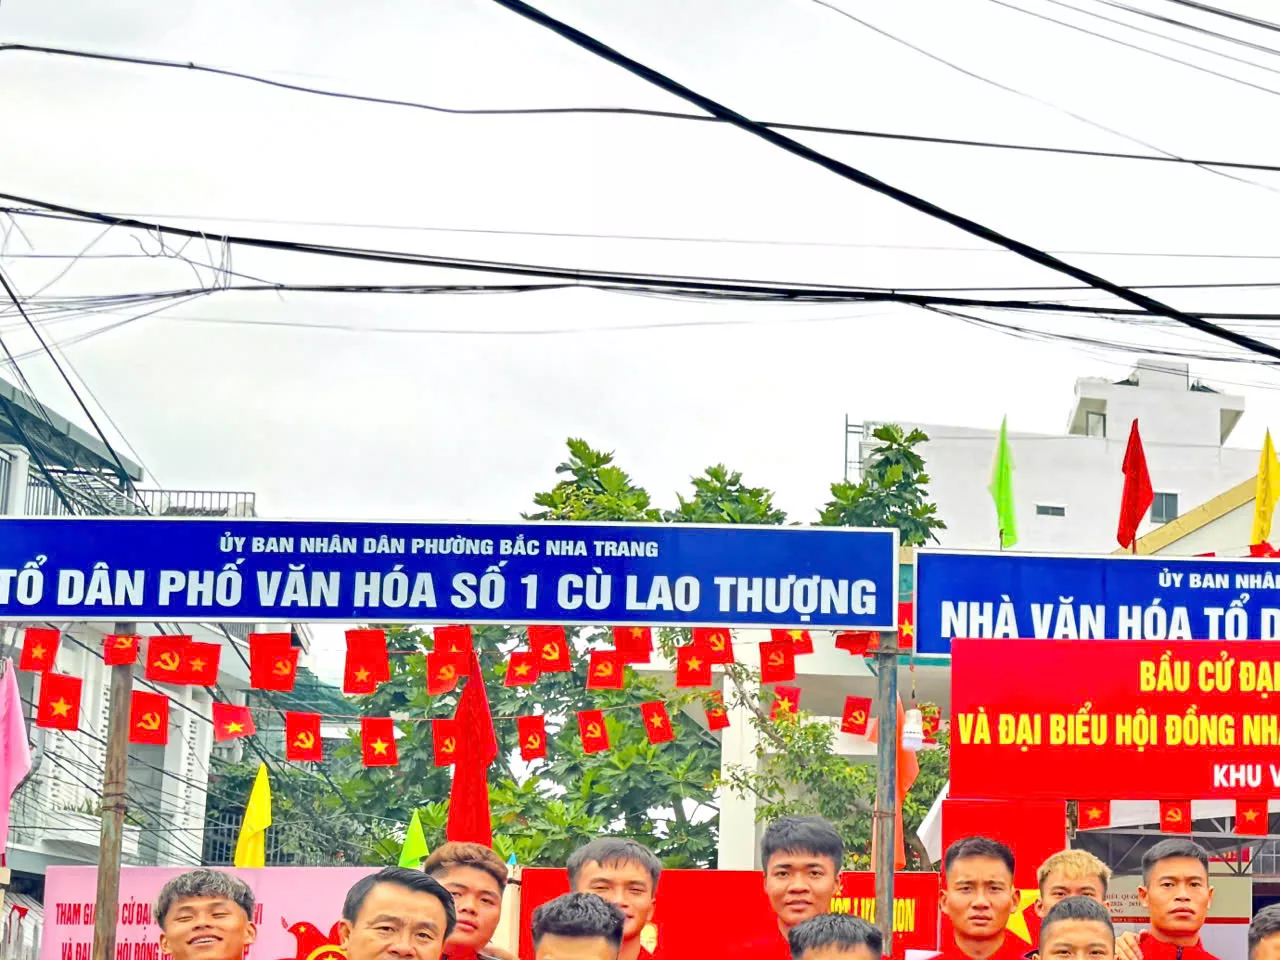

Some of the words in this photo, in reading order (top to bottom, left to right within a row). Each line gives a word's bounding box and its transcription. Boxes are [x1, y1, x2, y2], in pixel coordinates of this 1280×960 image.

[221, 532, 245, 552] ỦY
[252, 537, 293, 552] BAN
[301, 535, 356, 553] NHÂN
[364, 535, 404, 553] DÂN
[412, 535, 493, 554] PHƯỜNG
[500, 534, 539, 555] BẮC
[546, 541, 587, 556] NHA
[594, 541, 658, 557] TRANG
[0, 555, 47, 605] TỔ
[58, 562, 144, 605] DÂN
[159, 558, 245, 606] PHỐ
[257, 564, 340, 606] VĂN
[354, 565, 436, 607] HÓA
[451, 561, 507, 608] SỐ
[521, 575, 537, 608] 1
[558, 567, 611, 610] CÙ
[626, 576, 700, 611] LAO
[714, 575, 876, 621] THƯỢNG
[1159, 568, 1183, 587] ỦY
[1190, 574, 1229, 588] BAN
[941, 595, 1019, 640] NHÀ
[1031, 596, 1108, 640] VĂN
[1118, 598, 1193, 640] HÓA
[1204, 593, 1249, 641] TỔ
[1140, 650, 1190, 691] BẦU
[1199, 651, 1234, 692] CỬ
[1239, 661, 1280, 698] ĐẠI
[958, 707, 991, 744] VÀ
[998, 714, 1041, 751] ĐẠI
[1050, 702, 1107, 745] BIỂU
[1116, 708, 1157, 752] HỘI
[1165, 705, 1234, 745] ĐỒNG
[1214, 764, 1261, 787] KHU
[56, 903, 81, 925] THAM
[136, 903, 151, 929] ĐẠI
